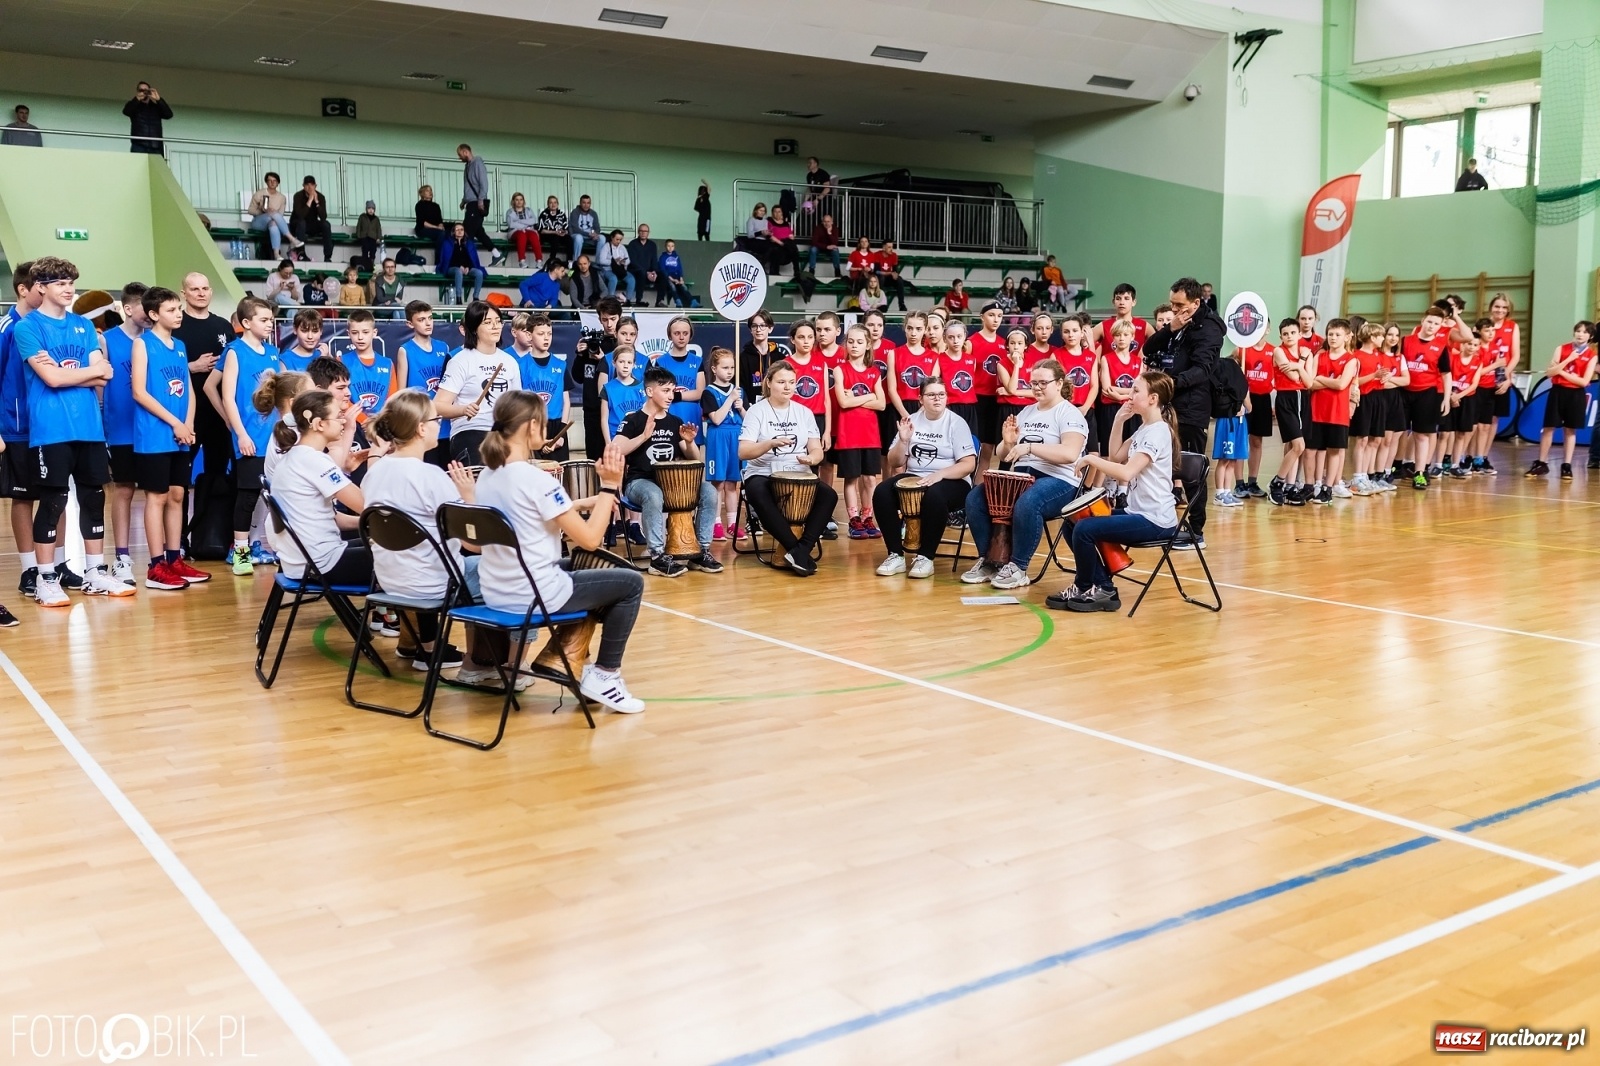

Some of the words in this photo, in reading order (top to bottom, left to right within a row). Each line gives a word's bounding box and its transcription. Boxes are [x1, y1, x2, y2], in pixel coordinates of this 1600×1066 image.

[326, 103, 340, 115] C
[347, 105, 355, 116] C
[778, 144, 791, 153] D
[719, 262, 760, 283] THUNDER
[50, 344, 86, 361] THUNDER
[353, 380, 386, 396] THUNDER
[1223, 441, 1234, 455] 23
[709, 460, 716, 475] 8
